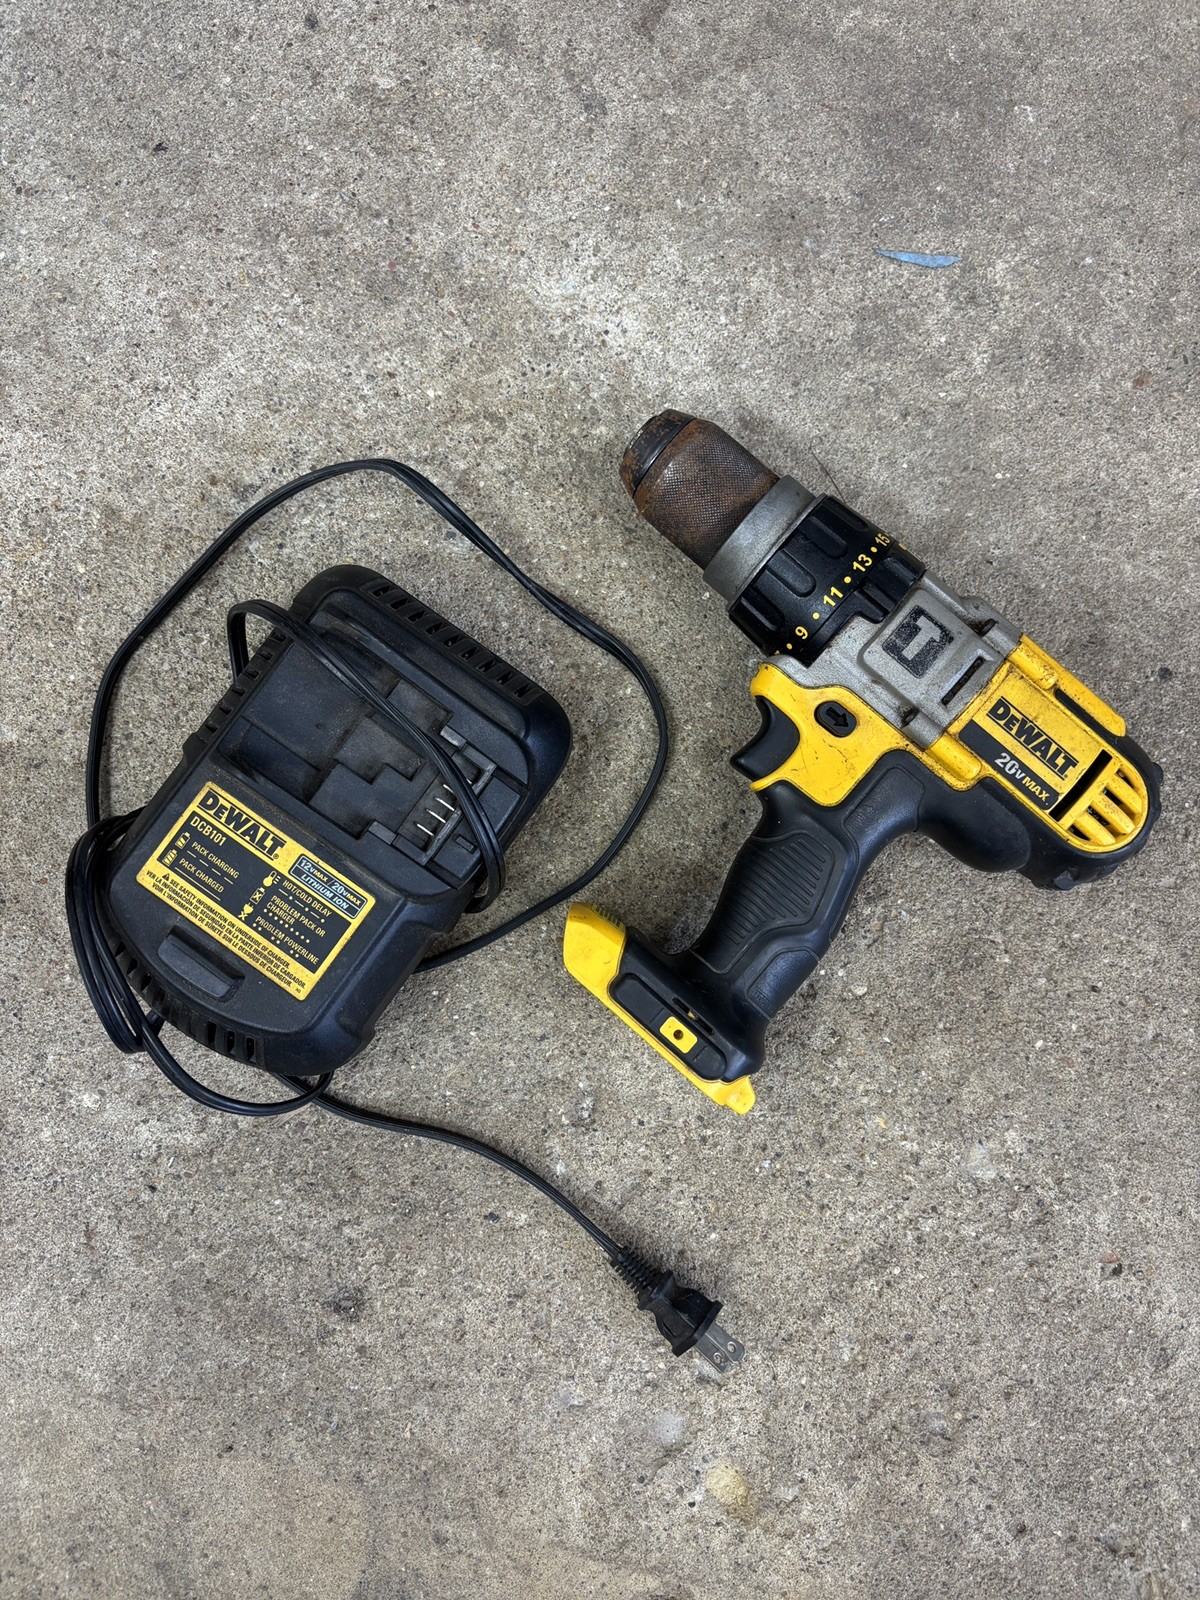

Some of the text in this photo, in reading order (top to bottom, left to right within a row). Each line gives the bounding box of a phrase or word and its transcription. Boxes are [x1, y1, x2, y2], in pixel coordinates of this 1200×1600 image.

[795, 533, 891, 639] 9 11 13 15
[189, 815, 227, 846] DCB101
[178, 857, 224, 893] PACK CHARGED
[190, 841, 240, 878] PACK CHARGING
[281, 879, 332, 918] HOT/COLD DELAY
[300, 872, 349, 910] LITHIUM ION
[145, 869, 156, 880] VER
[154, 876, 163, 884] LA
[192, 903, 201, 912] DE
[198, 908, 226, 930] SEGURIDAD
[224, 926, 233, 935] EN
[231, 931, 240, 940] LA
[237, 936, 254, 950] PARTE
[252, 947, 274, 965] INFERIOR
[272, 961, 281, 970] DE
[151, 882, 164, 894] VOIR
[197, 915, 206, 924] DE
[221, 933, 233, 944] SUR
[231, 940, 239, 948] LE
[237, 944, 260, 964] DESSOUS
[258, 960, 267, 969] DE
[169, 878, 291, 969] SEE SAFETY INFORMATION ON UNDERSIDE OF CHARGER.
[265, 901, 295, 925] CHARGER
[270, 894, 326, 937] PROBLEM PACK OR
[254, 915, 319, 965] PROBLEM POWERLINE
